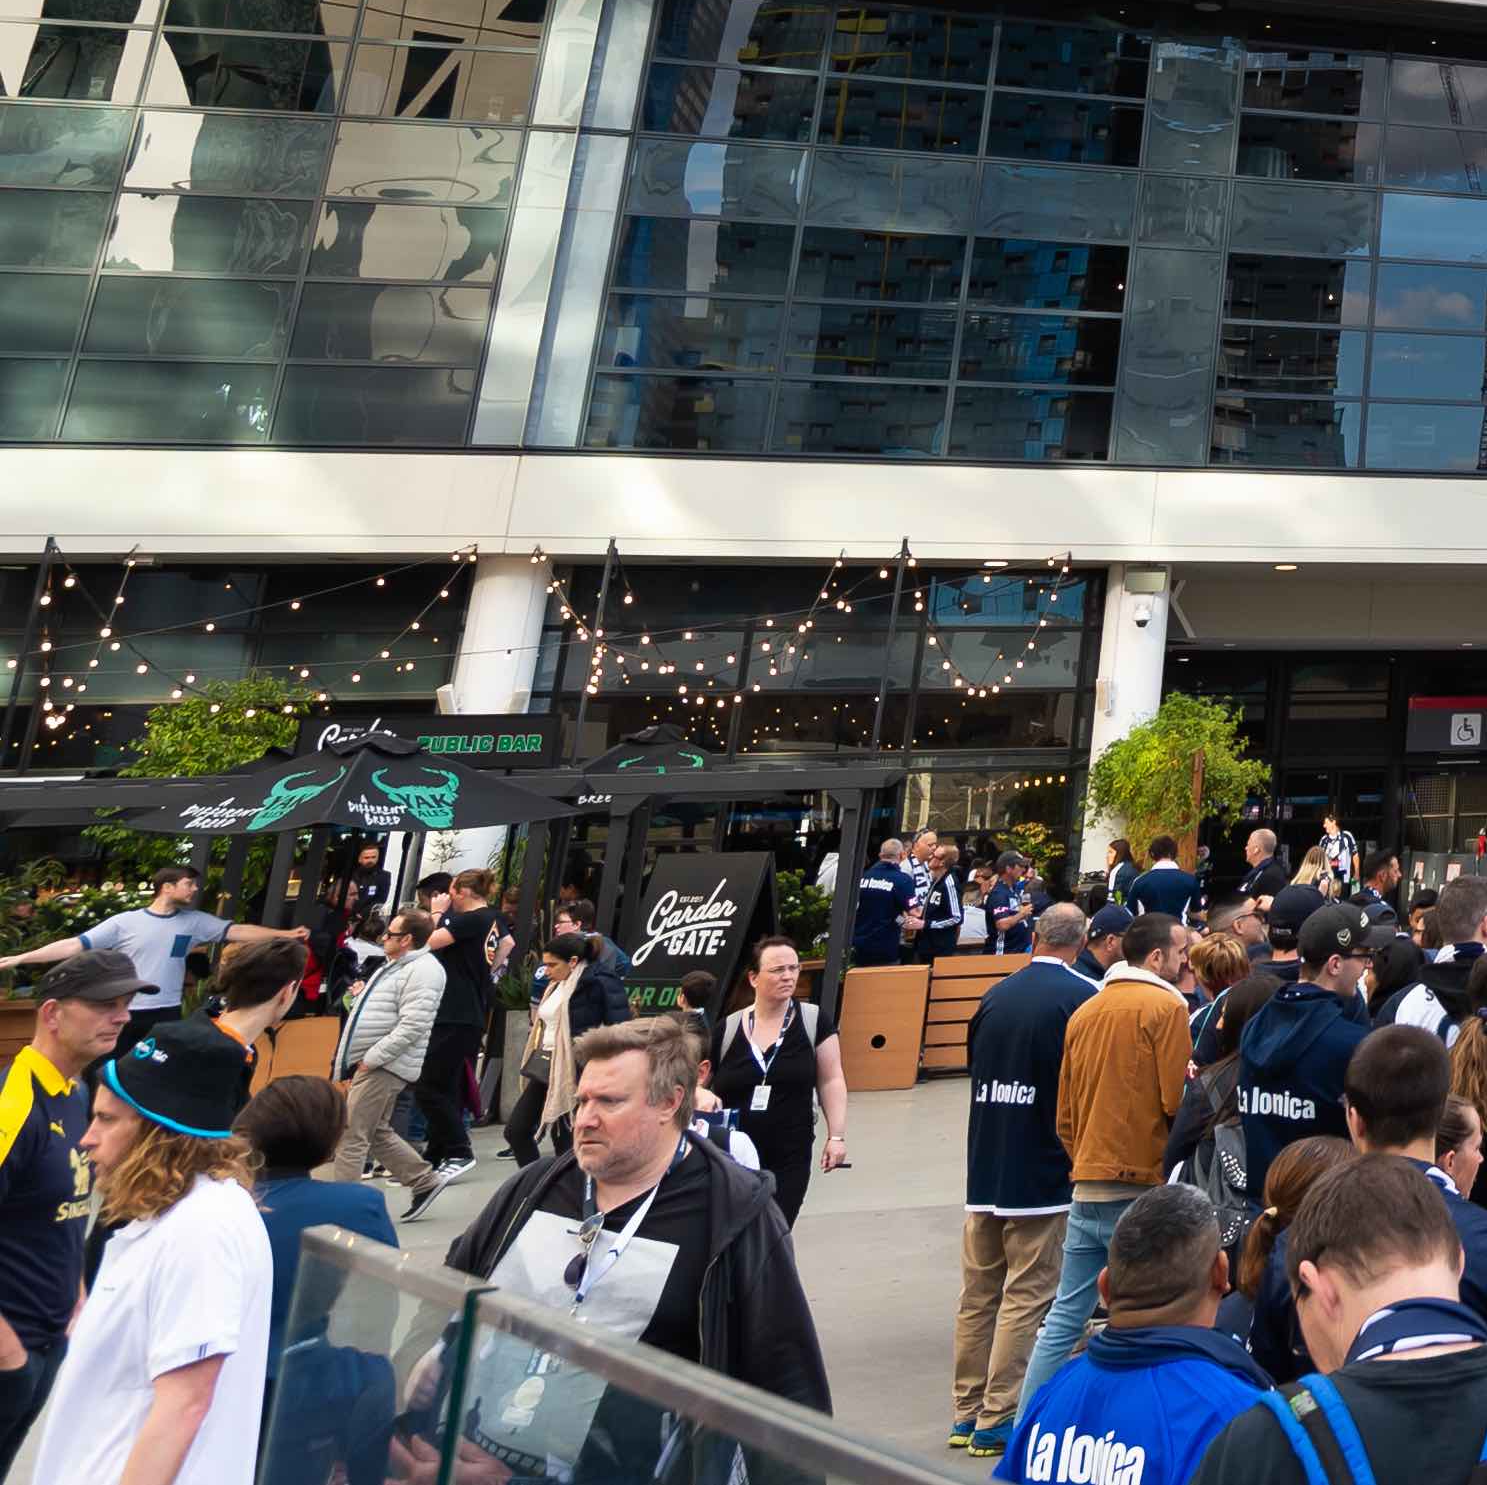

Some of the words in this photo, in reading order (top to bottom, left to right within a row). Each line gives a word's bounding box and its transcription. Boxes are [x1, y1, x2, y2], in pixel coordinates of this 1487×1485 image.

[418, 734, 493, 754] PUBLIC
[497, 734, 543, 754] BAR
[399, 793, 454, 809] YAK
[364, 812, 400, 826] BREED
[632, 877, 738, 967] Garden
[666, 929, 724, 956] GATE
[976, 1078, 989, 1104] La
[991, 1079, 1037, 1105] Ionica
[1251, 1086, 1316, 1121] Ionica
[1026, 1421, 1057, 1482] La
[1057, 1424, 1146, 1485] Ionica
